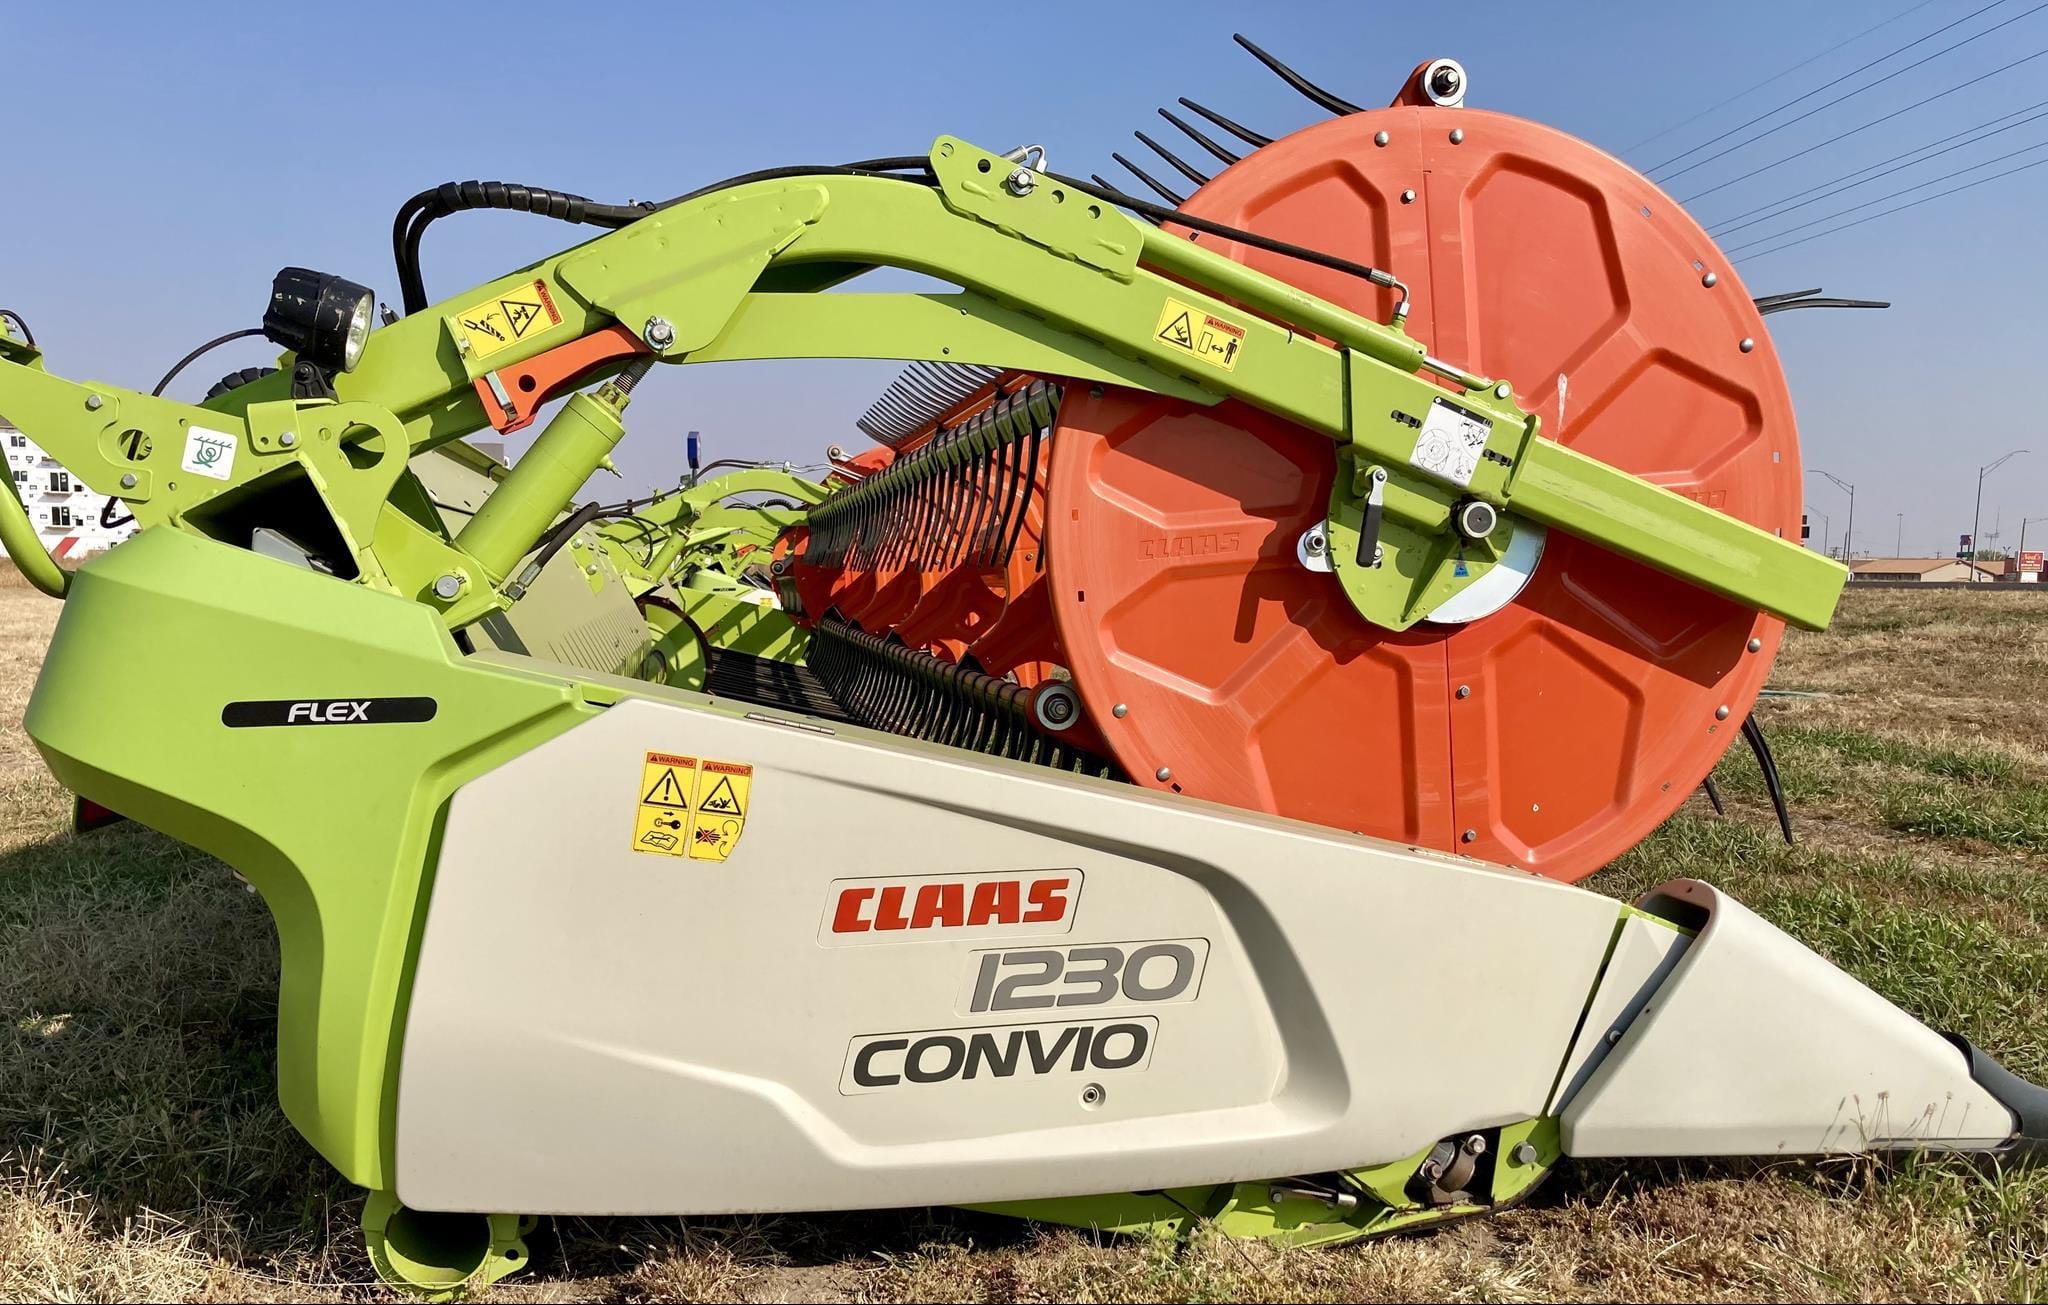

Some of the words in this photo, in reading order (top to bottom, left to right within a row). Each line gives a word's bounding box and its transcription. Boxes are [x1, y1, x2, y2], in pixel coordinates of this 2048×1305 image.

[540, 291, 559, 322] WARNING
[1214, 320, 1242, 337] WARNING
[1137, 532, 1241, 561] CLAAS
[287, 701, 372, 722] FLEX
[658, 755, 694, 767] WARNING
[712, 764, 750, 775] WARNING
[832, 878, 1070, 934] CLAAS
[969, 944, 1195, 1013] 1230
[853, 1023, 1149, 1088] CONVIO
